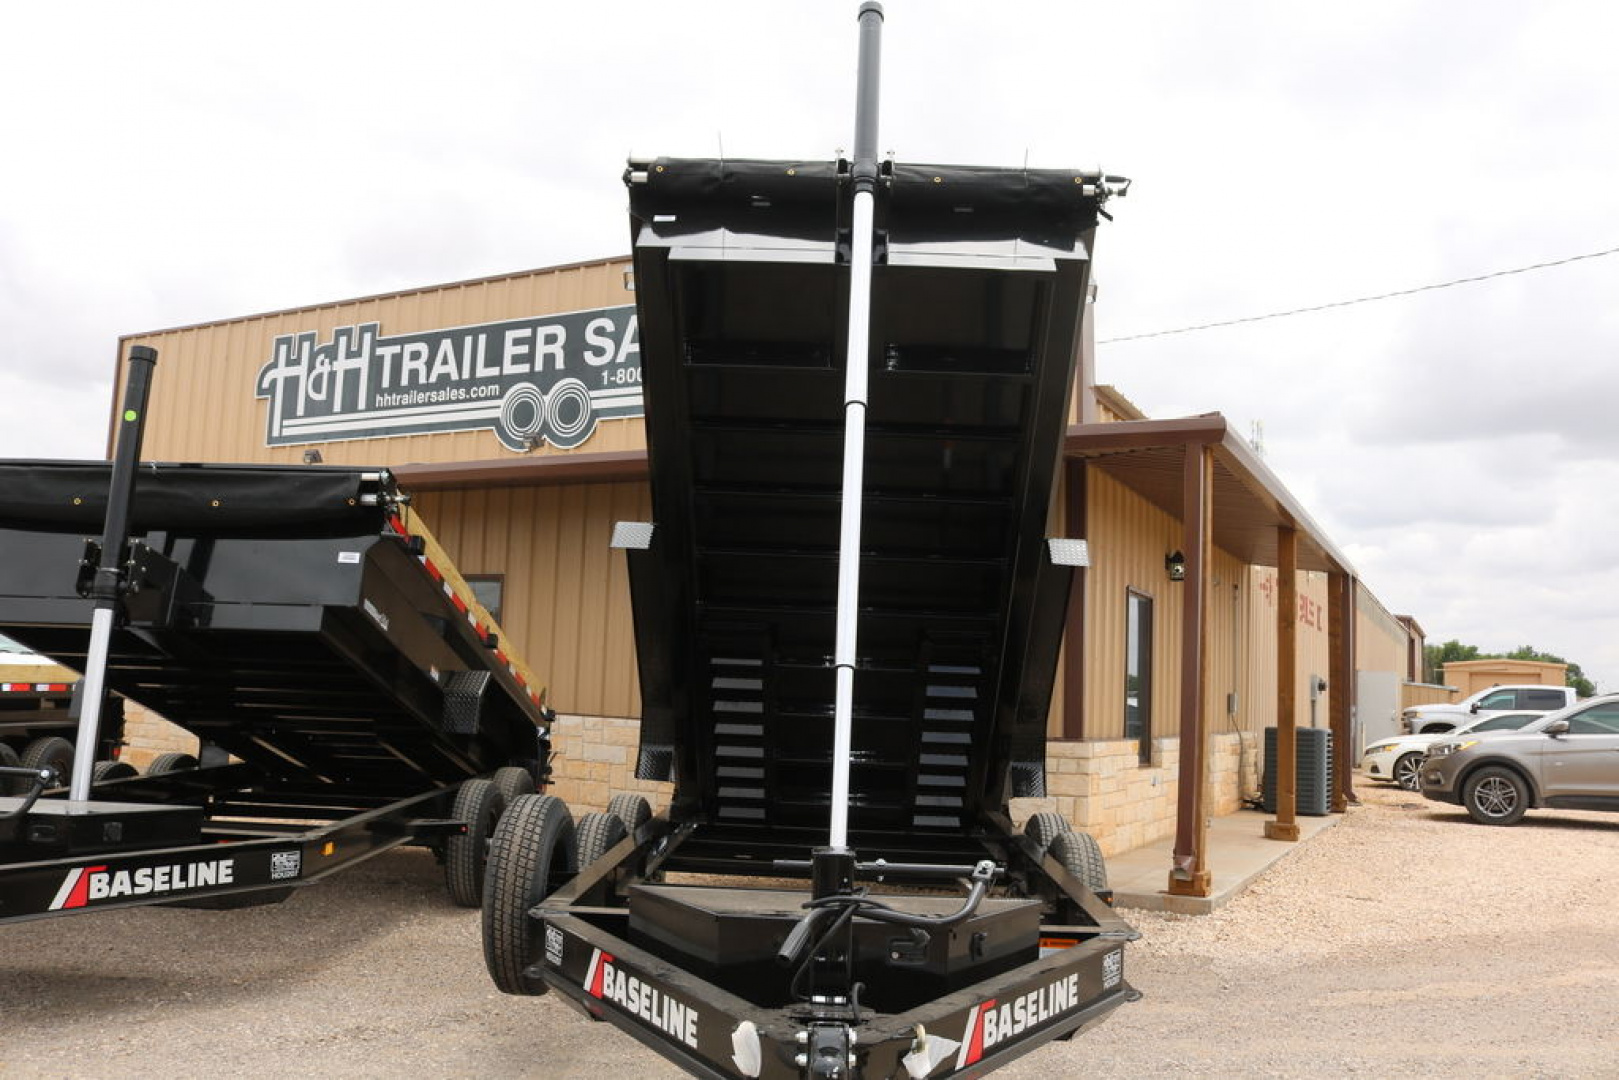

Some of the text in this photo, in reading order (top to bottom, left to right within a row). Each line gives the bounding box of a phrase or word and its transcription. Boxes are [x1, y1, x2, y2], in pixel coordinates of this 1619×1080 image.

[262, 331, 372, 438] H&H
[375, 324, 567, 389] TRAILER
[375, 383, 500, 409] hhtrailersales.com
[88, 859, 235, 900] BASELINE
[603, 961, 699, 1050] BASELINE
[983, 972, 1079, 1049] BASELINE
